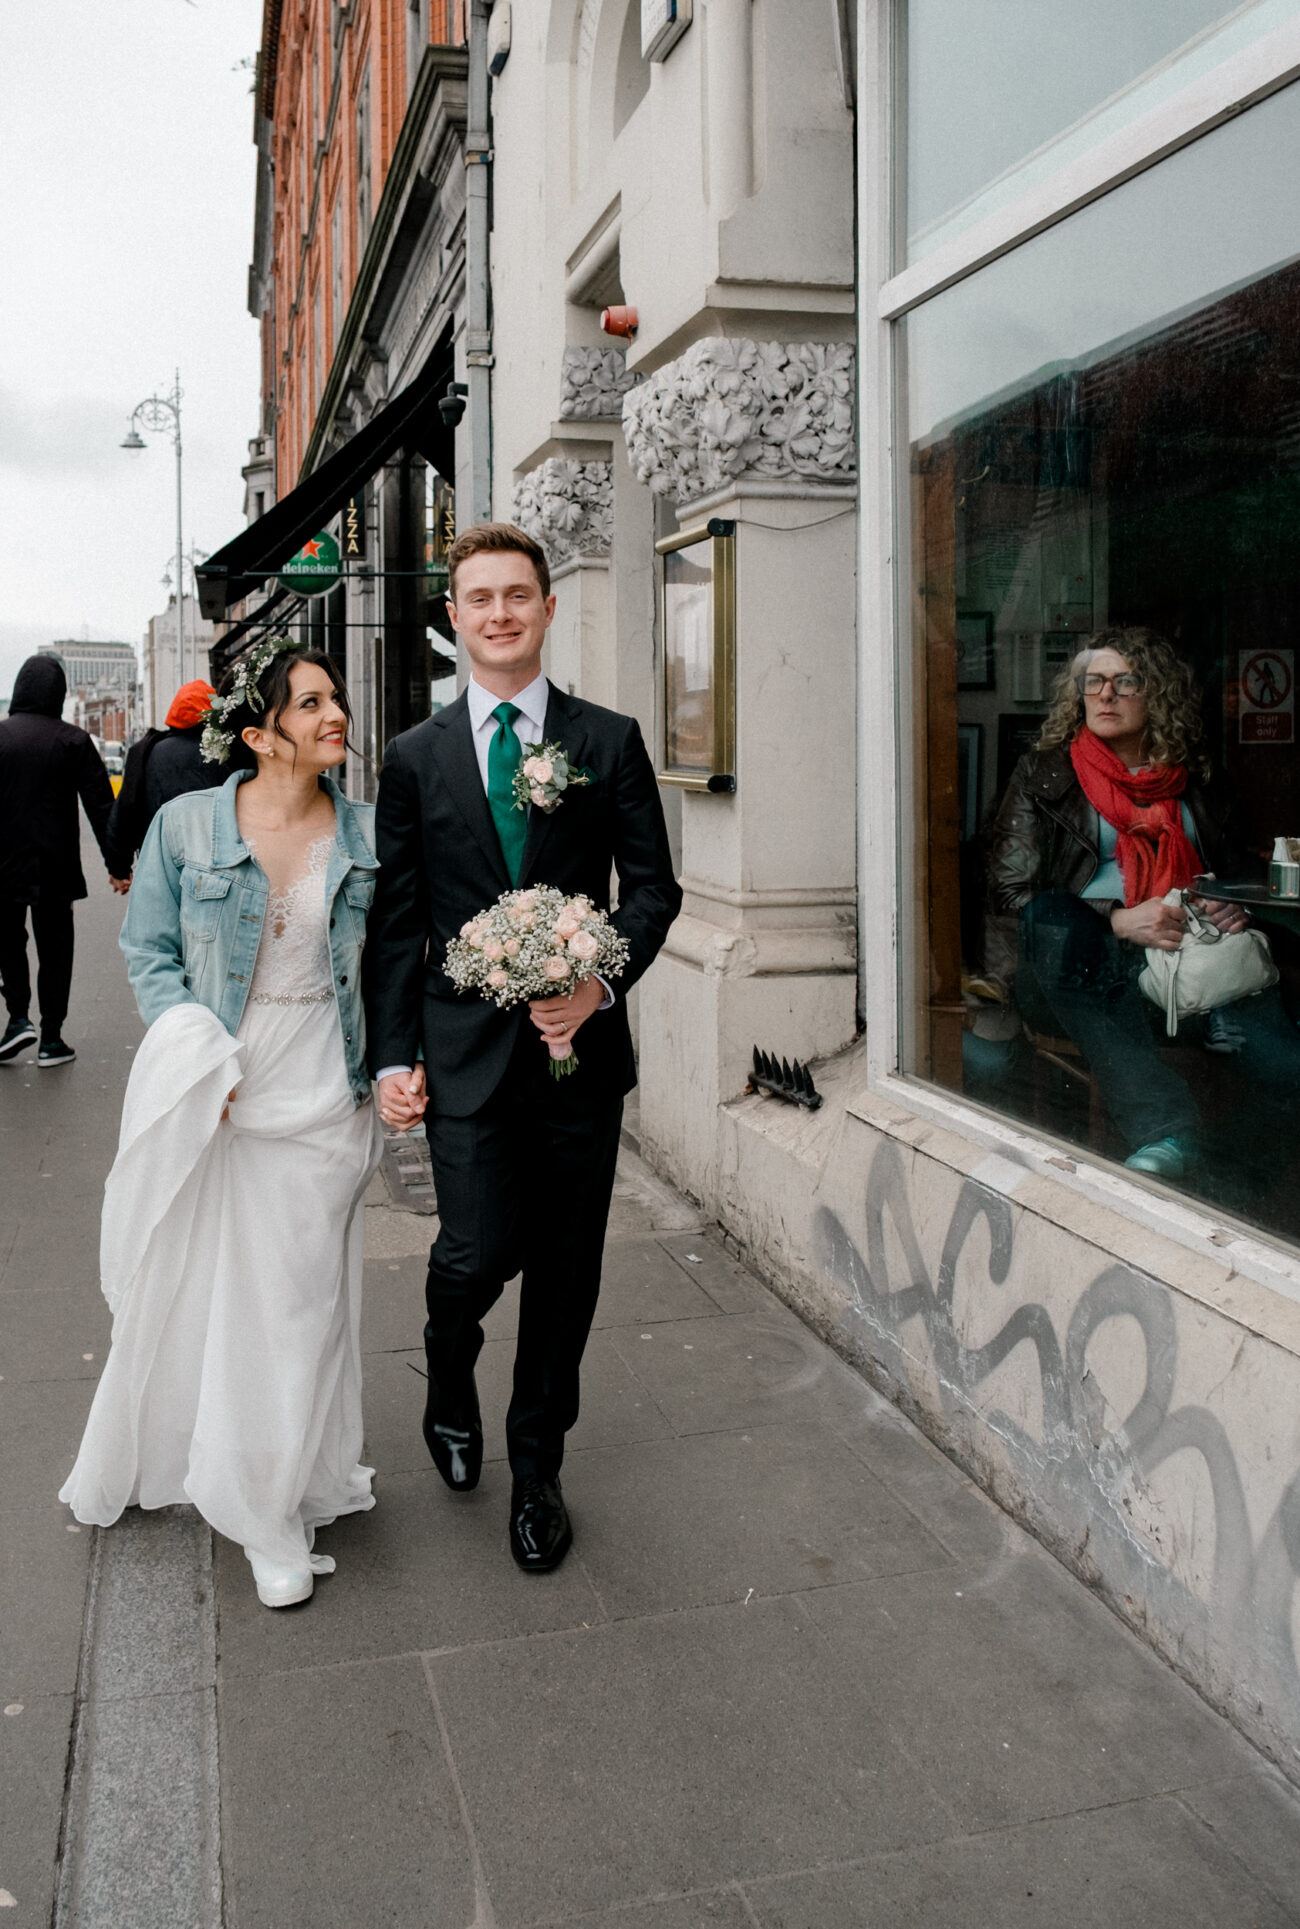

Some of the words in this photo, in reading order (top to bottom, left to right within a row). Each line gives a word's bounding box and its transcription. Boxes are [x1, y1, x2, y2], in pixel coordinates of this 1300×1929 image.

[346, 497, 359, 553] IZZA
[282, 562, 338, 574] Heineken
[1256, 716, 1278, 725] Staff
[1256, 727, 1277, 737] only
